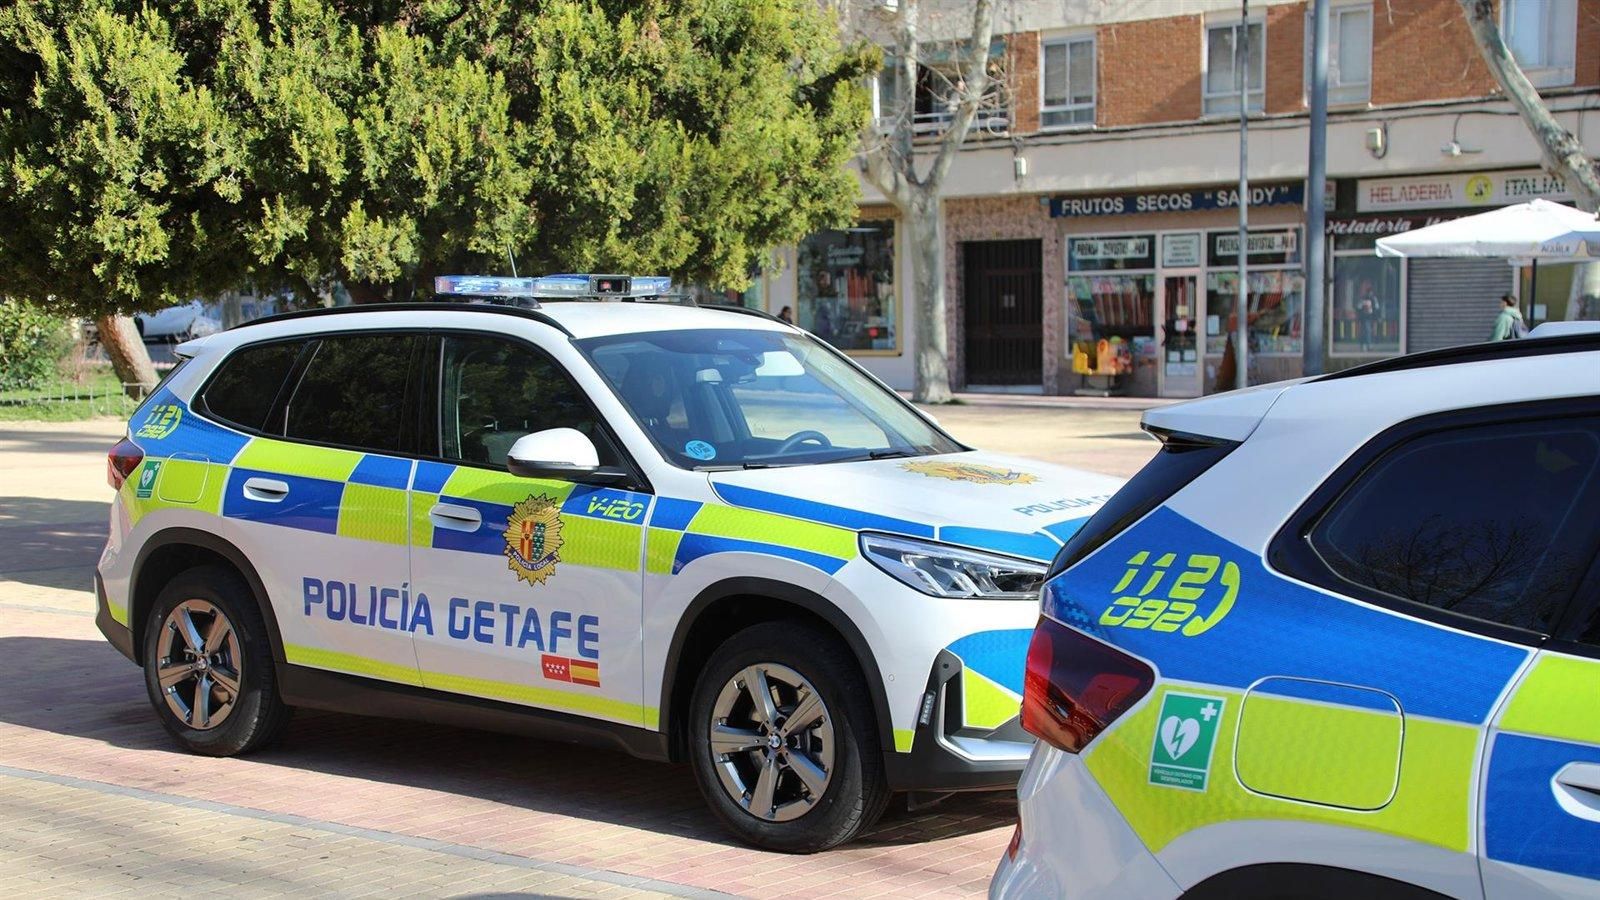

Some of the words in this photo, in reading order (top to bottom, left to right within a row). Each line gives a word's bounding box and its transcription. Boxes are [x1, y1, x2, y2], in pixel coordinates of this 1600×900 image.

[1062, 197, 1124, 215] FRUTOS
[1136, 193, 1193, 212] SECOS
[1370, 183, 1453, 203] HELADERIA
[143, 404, 178, 425] 112
[587, 495, 644, 521] V-120
[533, 558, 550, 570] LOCAL
[1111, 550, 1221, 601] 112
[303, 577, 434, 636] POLICÍA
[448, 597, 600, 659] GETAFE
[1098, 596, 1198, 633] 092
